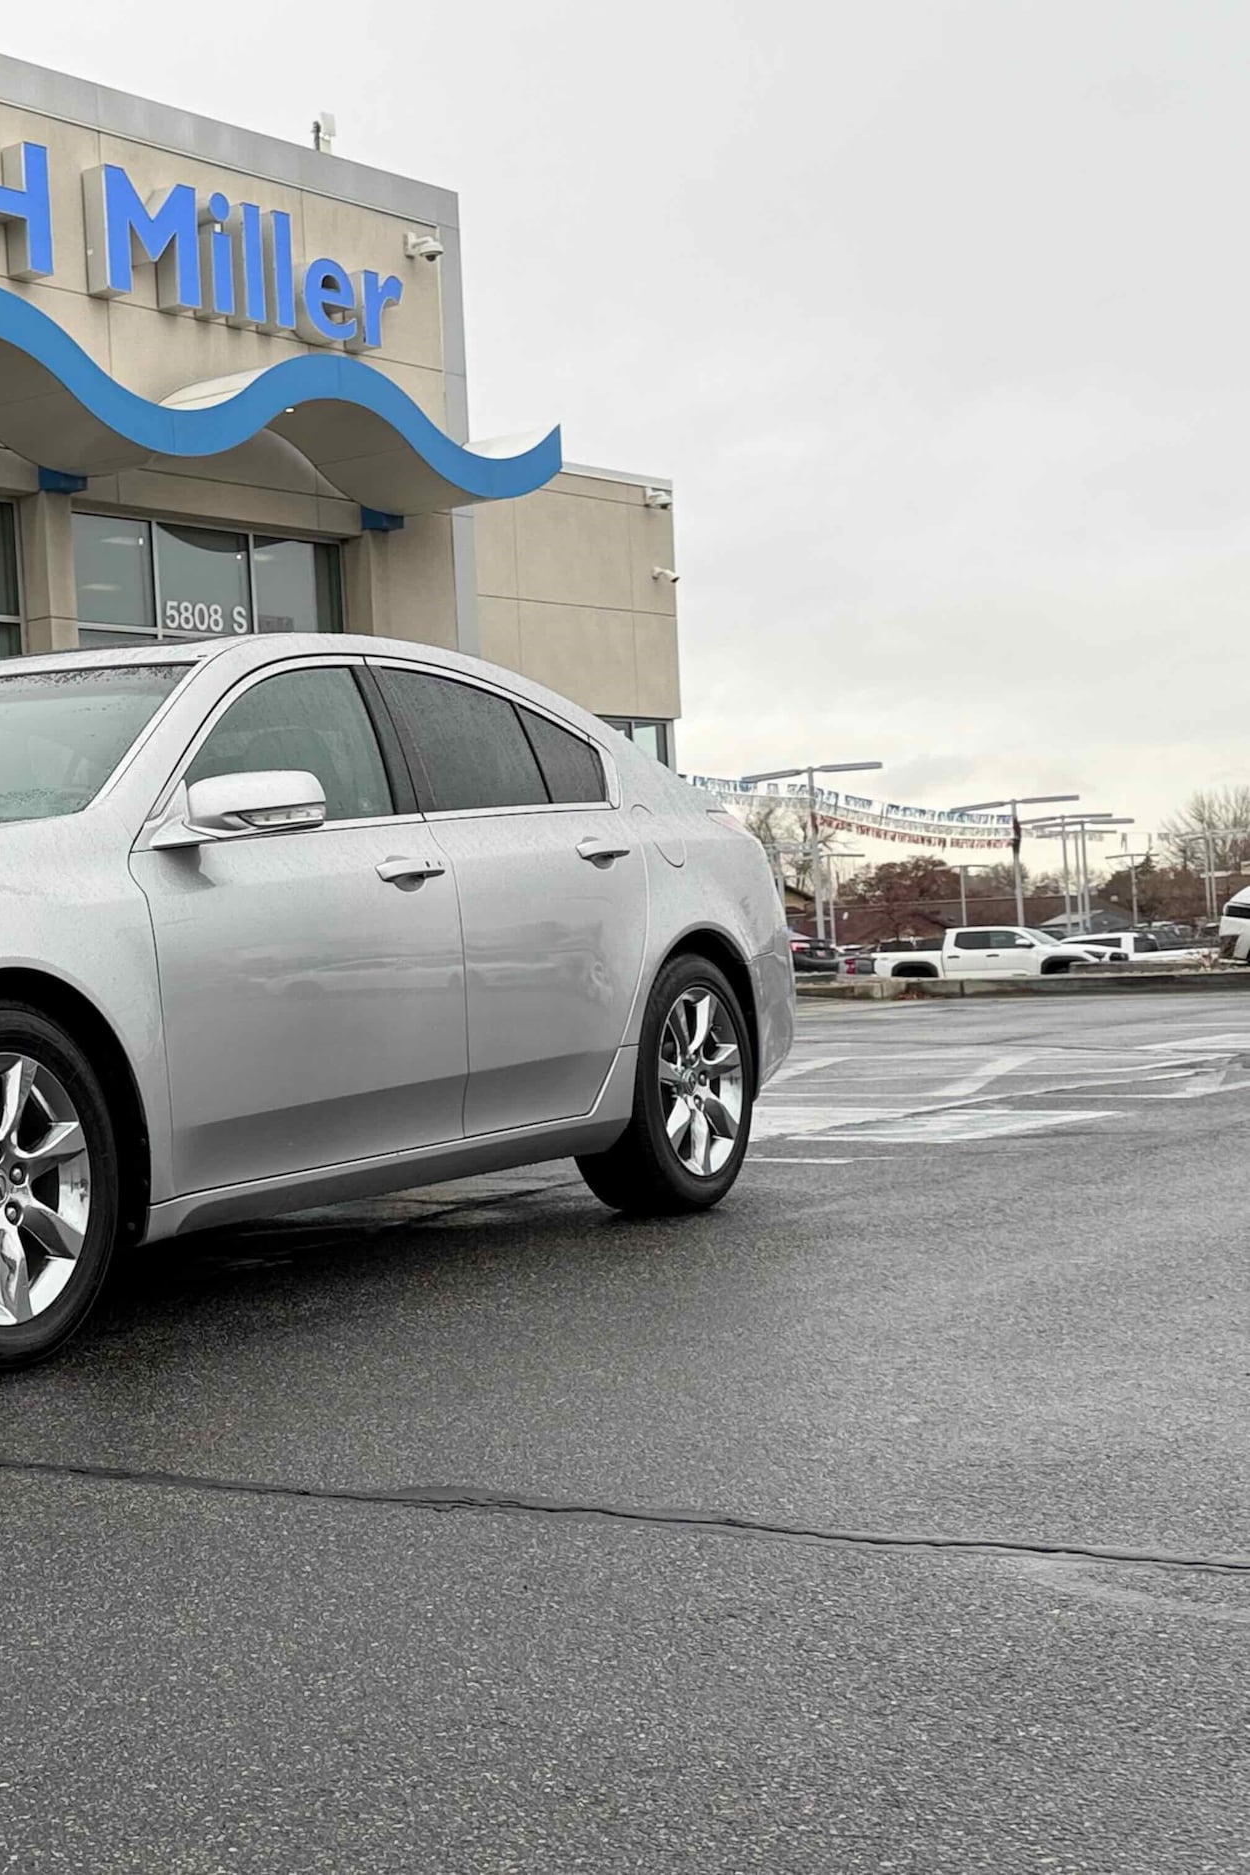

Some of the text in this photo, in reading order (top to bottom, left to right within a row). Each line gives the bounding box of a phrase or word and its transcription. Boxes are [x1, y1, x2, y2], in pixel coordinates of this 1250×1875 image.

[90, 163, 404, 350] Miller
[165, 600, 248, 634] 5808 S
